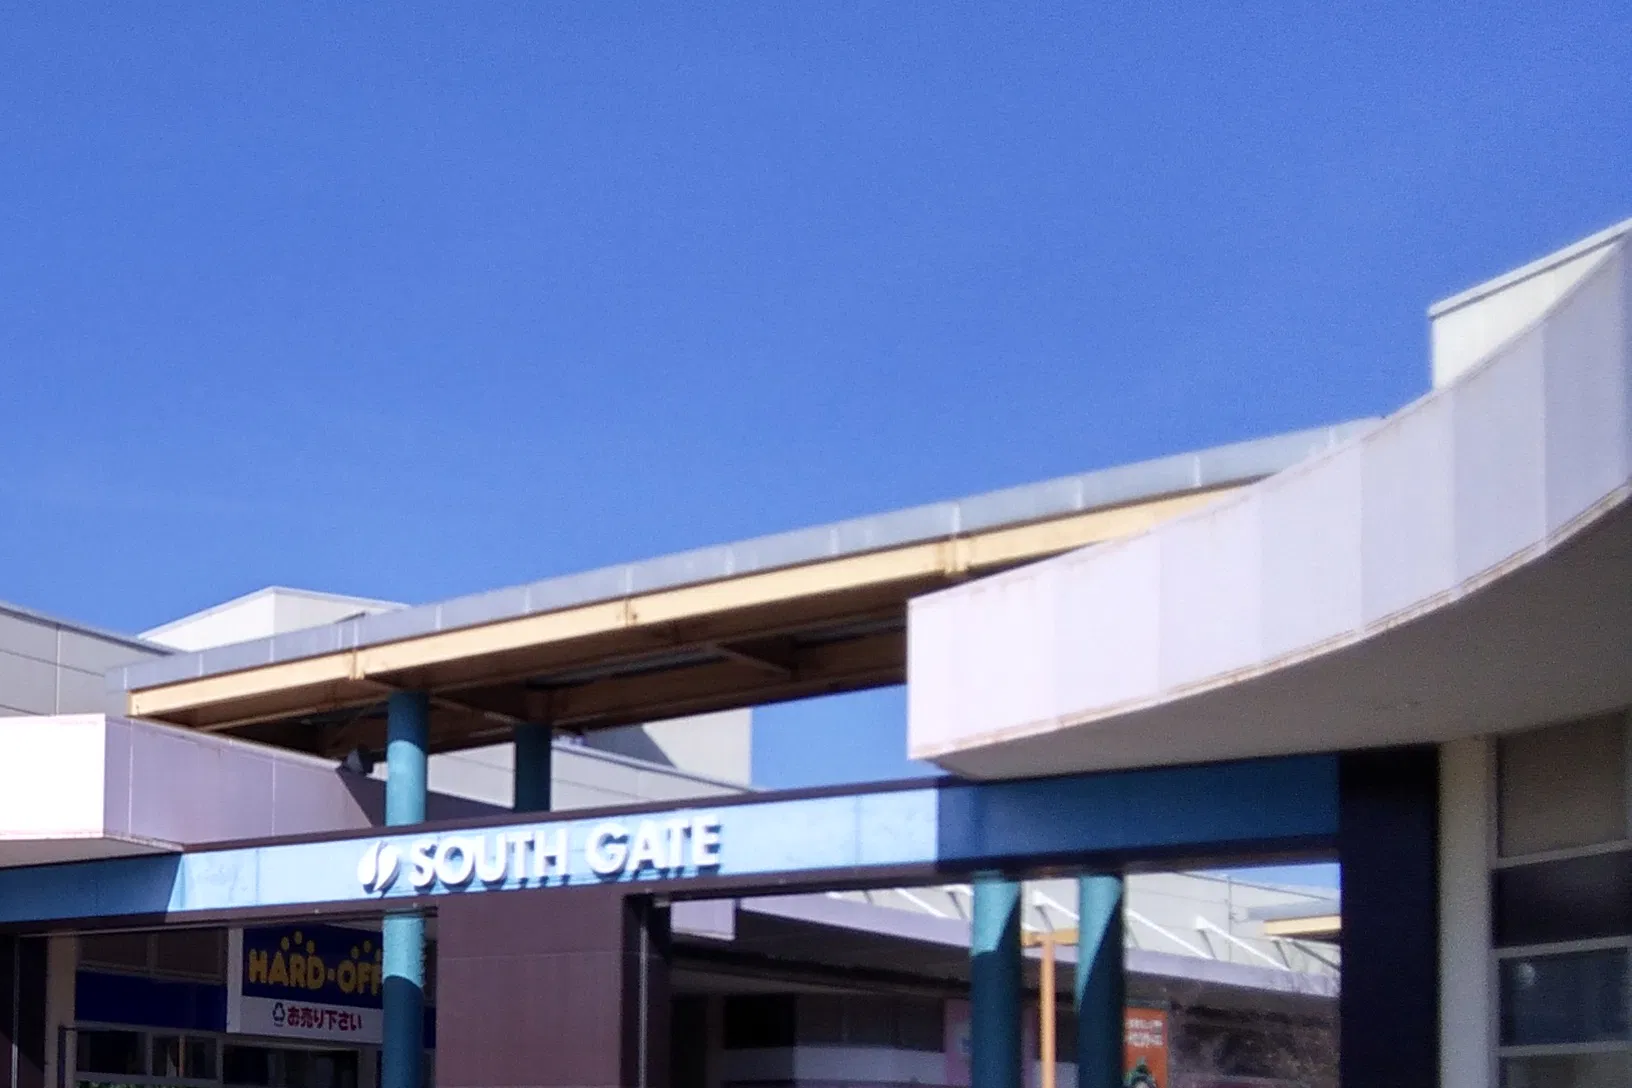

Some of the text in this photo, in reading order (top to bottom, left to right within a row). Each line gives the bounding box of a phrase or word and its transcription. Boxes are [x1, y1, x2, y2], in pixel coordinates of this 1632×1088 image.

[408, 815, 721, 888] SOUTH GATE
[287, 1006, 363, 1032] お売り下さい
